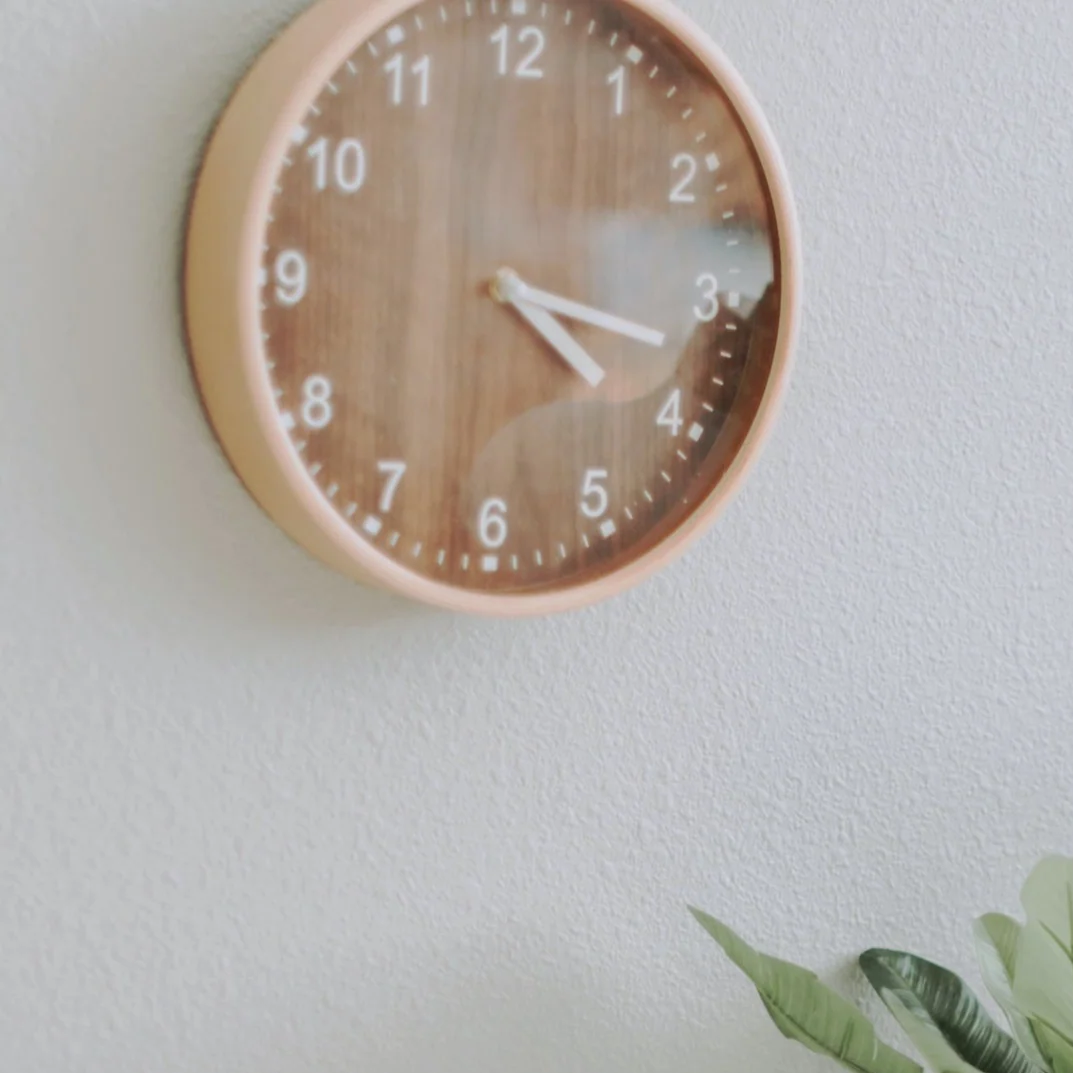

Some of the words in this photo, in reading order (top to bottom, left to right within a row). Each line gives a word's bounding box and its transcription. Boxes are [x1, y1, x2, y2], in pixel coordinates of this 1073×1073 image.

[491, 26, 544, 79] 12
[384, 54, 430, 106] 11
[607, 65, 626, 115] 1
[307, 139, 366, 193] 10
[669, 153, 697, 203] 2
[274, 251, 308, 305] 9
[694, 274, 718, 321] 3
[301, 376, 333, 429] 8
[656, 390, 683, 436] 4
[377, 462, 406, 512] 7
[581, 470, 609, 518] 5
[477, 498, 508, 548] 6
